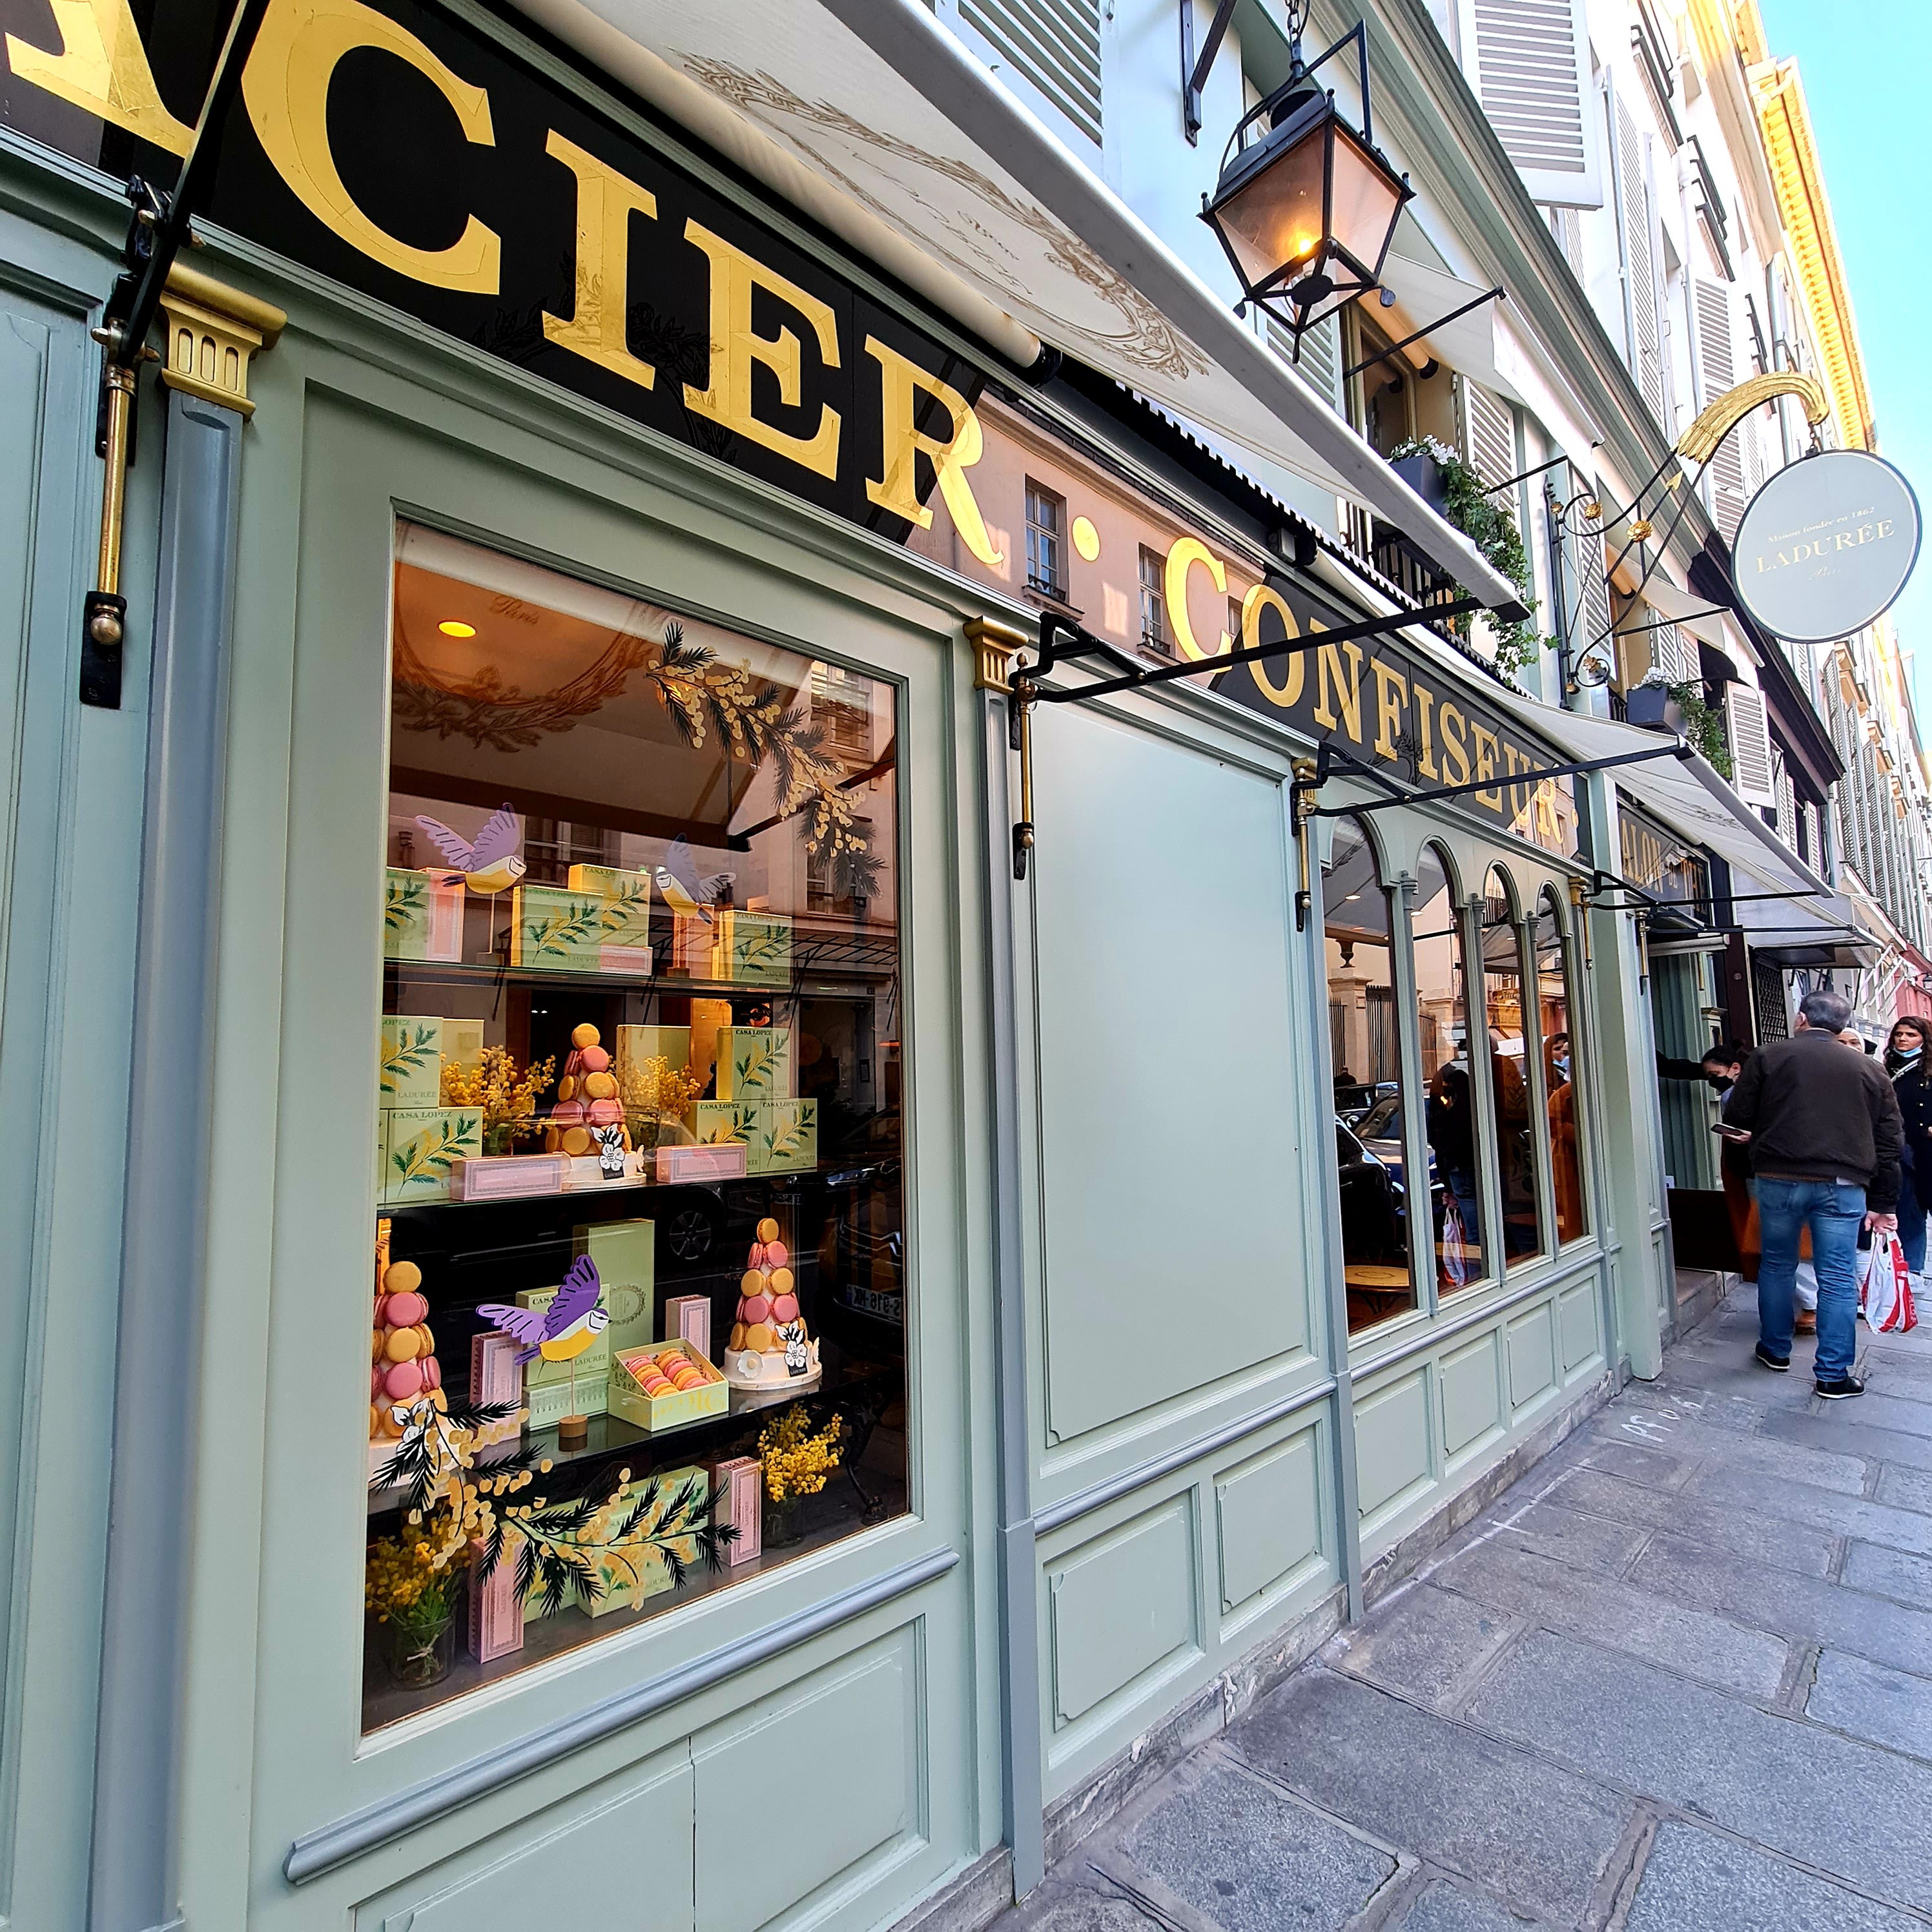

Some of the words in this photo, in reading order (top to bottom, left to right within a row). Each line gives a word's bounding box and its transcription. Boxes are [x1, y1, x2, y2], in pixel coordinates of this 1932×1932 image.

[1851, 506, 1875, 519] 1862
[1756, 519, 1896, 573] LADURÉE
[1166, 537, 1563, 845] CONFISEUR
[1622, 818, 1664, 894] ALON
[422, 1111, 452, 1119] LOPEZ
[575, 1353, 607, 1366] LADURÉE
